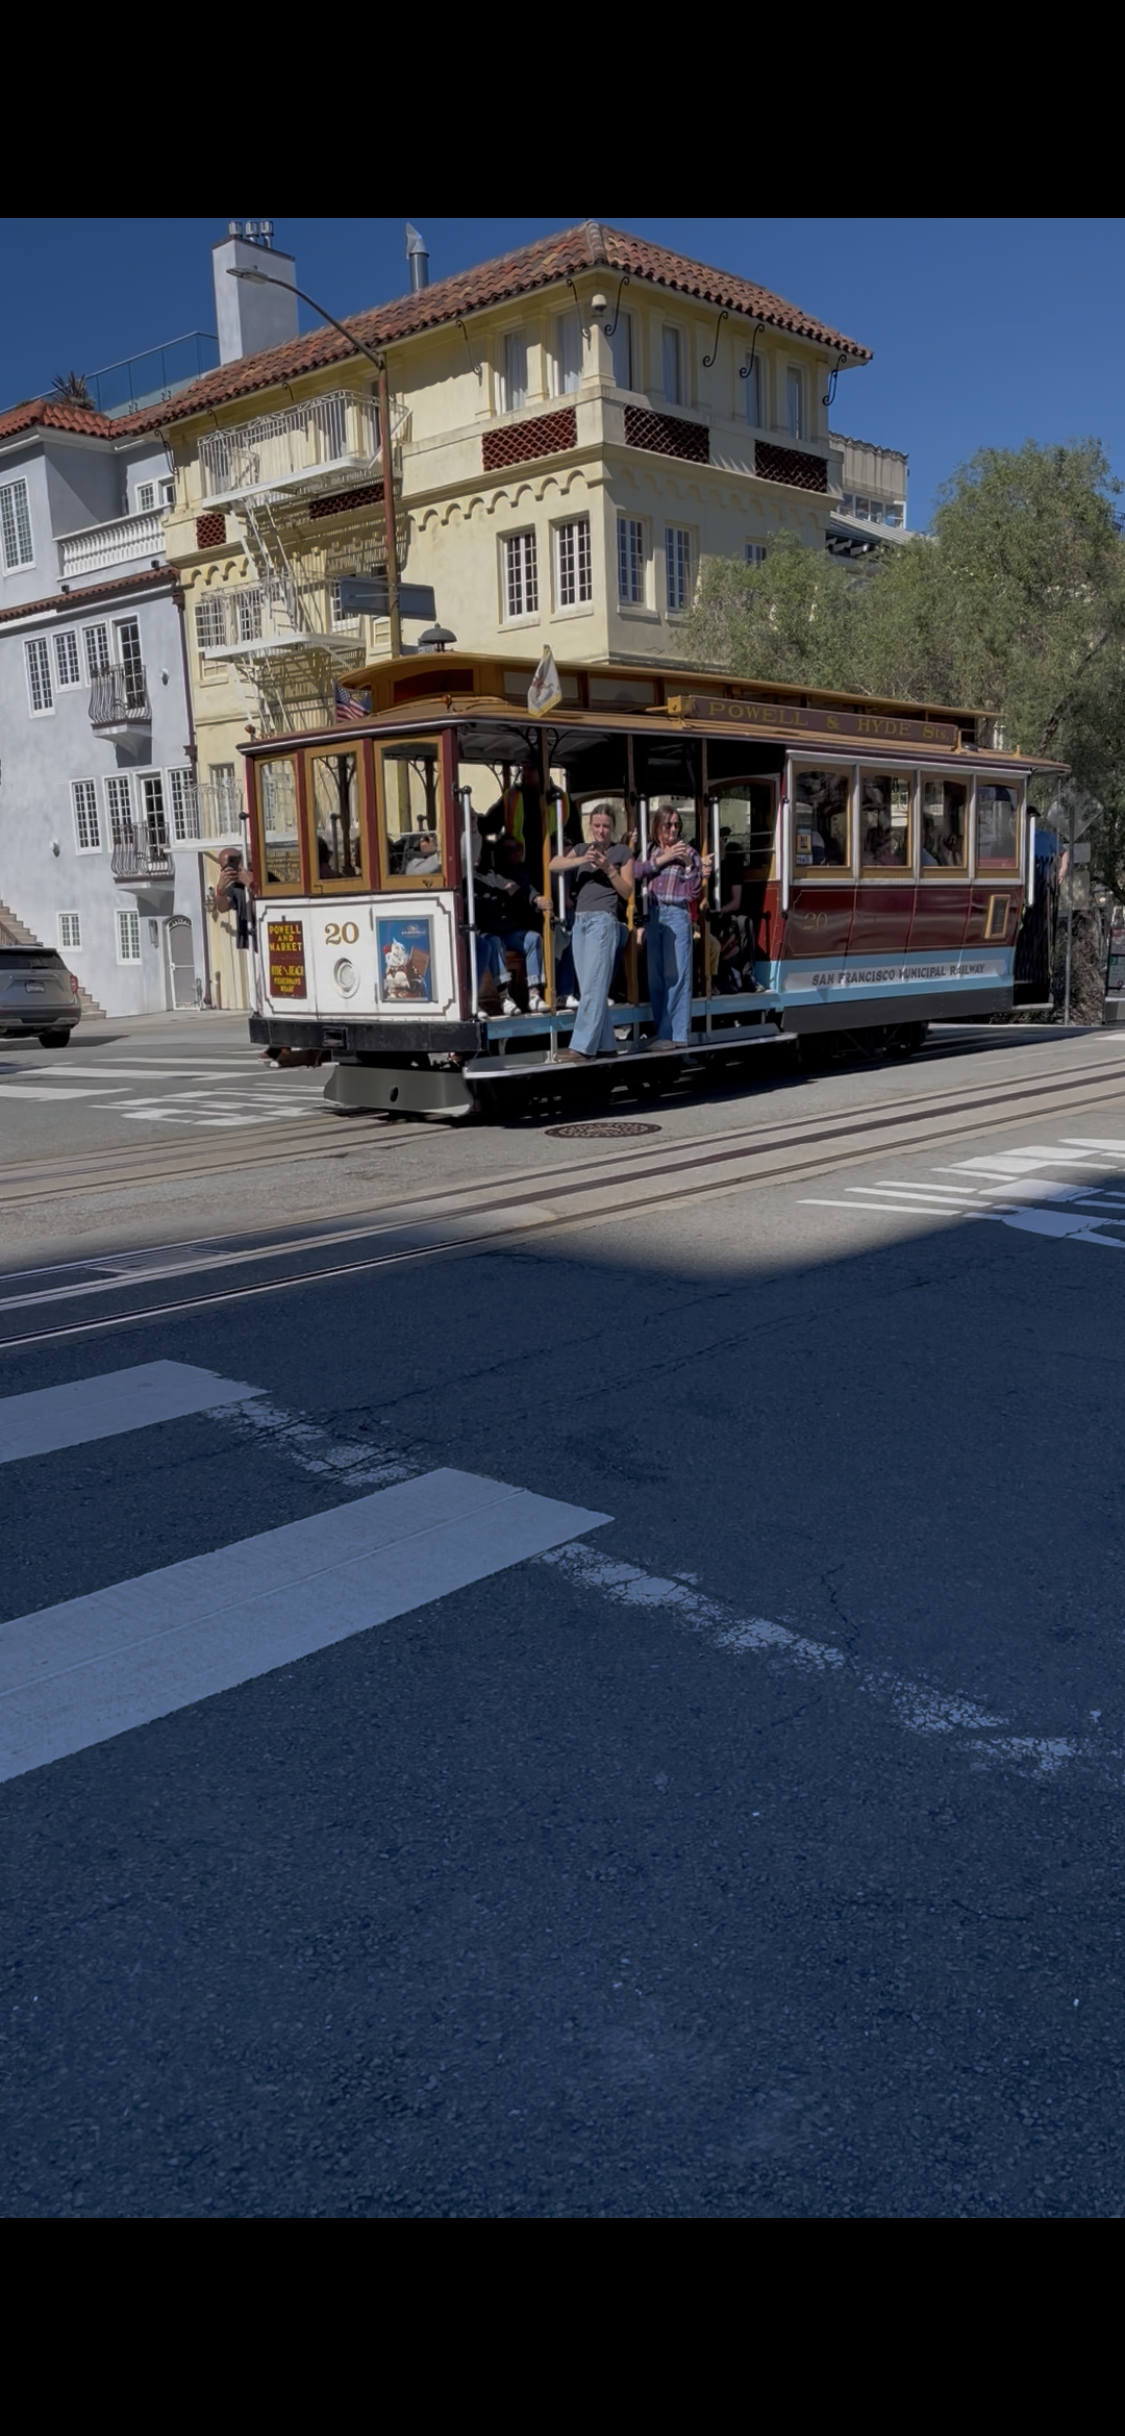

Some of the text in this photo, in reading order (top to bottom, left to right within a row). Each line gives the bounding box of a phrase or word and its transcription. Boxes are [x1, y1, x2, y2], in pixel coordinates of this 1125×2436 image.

[708, 701, 808, 727] POWELL
[825, 716, 840, 730] &
[857, 718, 912, 736] HYDE
[269, 925, 301, 935] POWELL
[802, 912, 828, 930] 20
[277, 934, 294, 942] AND
[324, 921, 360, 945] 20
[269, 942, 302, 952] MARKET
[811, 963, 986, 986] SAN FRANCISCO MUNICIPAL RAILWAY
